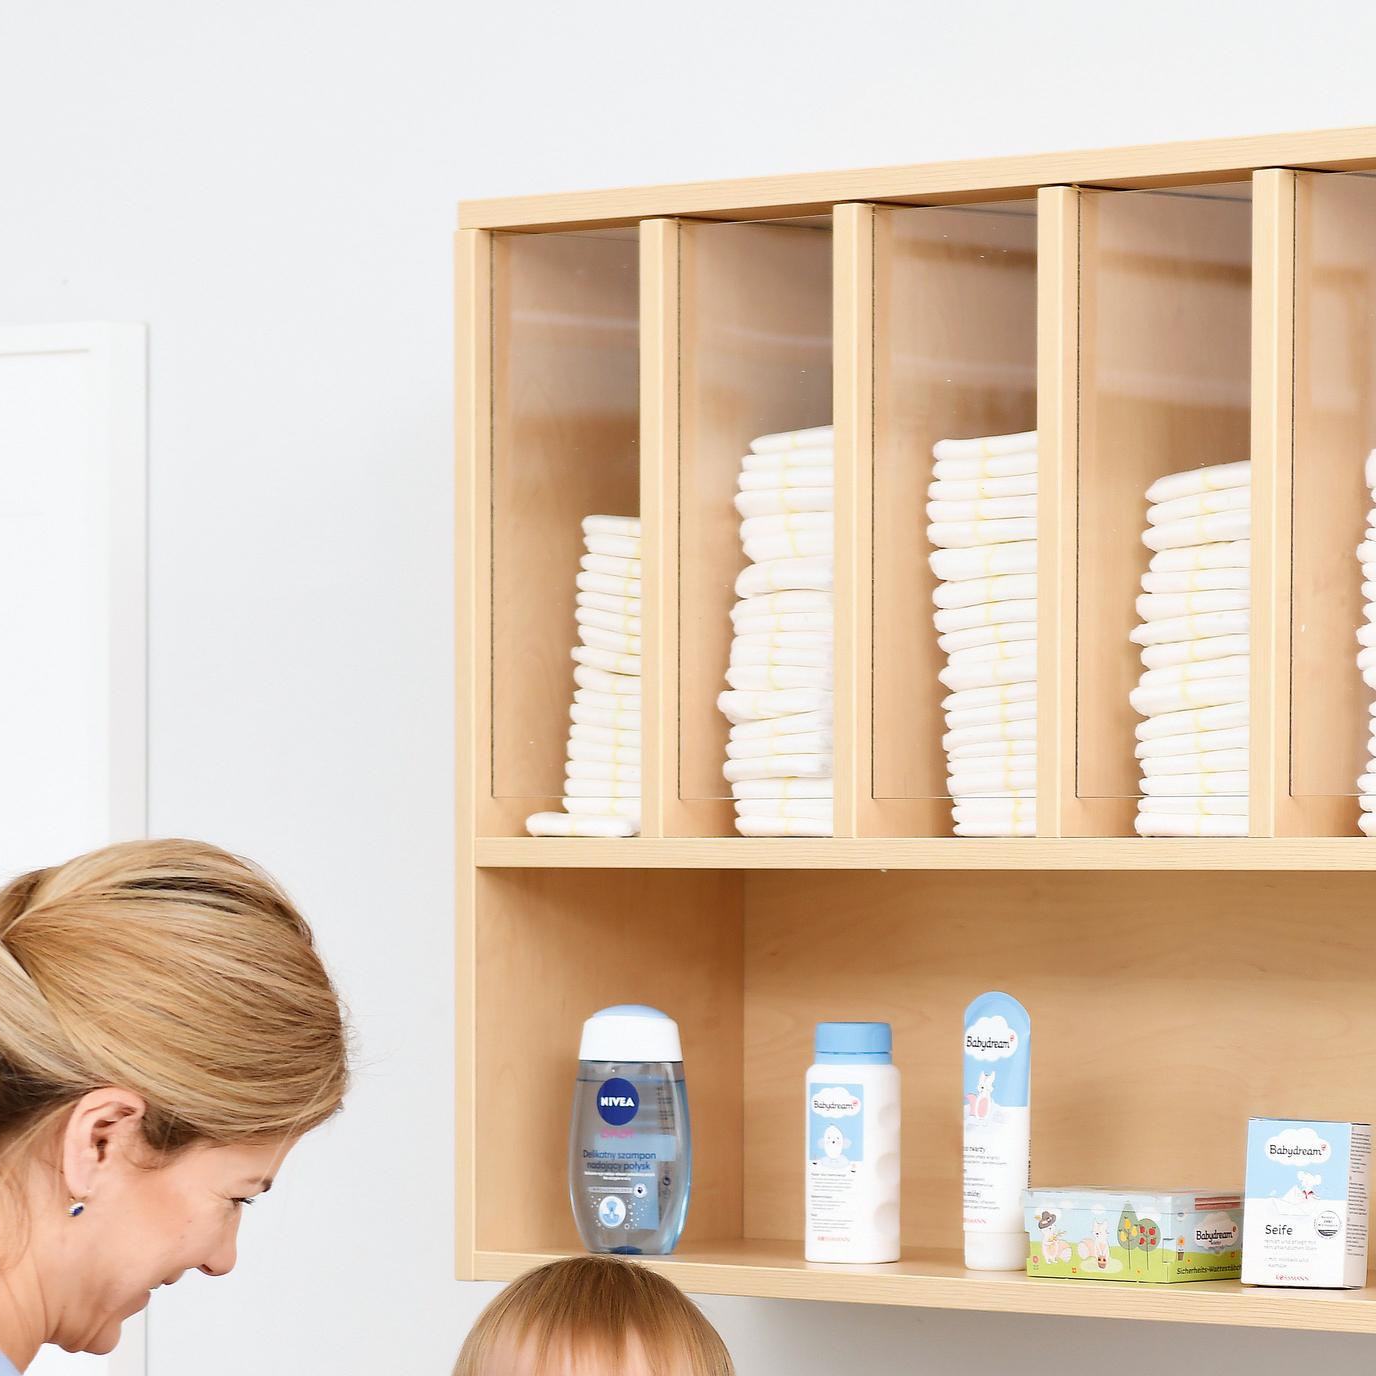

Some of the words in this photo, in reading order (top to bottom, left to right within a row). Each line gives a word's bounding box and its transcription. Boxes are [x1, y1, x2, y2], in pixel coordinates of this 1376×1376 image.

[966, 1035, 1010, 1052] Babydream
[600, 1096, 635, 1107] NIVEA
[813, 1100, 854, 1111] Babydream
[618, 1151, 657, 1161] szampon
[1269, 1144, 1322, 1158] Babydream
[1196, 1229, 1233, 1243] Babydream
[1265, 1224, 1293, 1236] Seife
